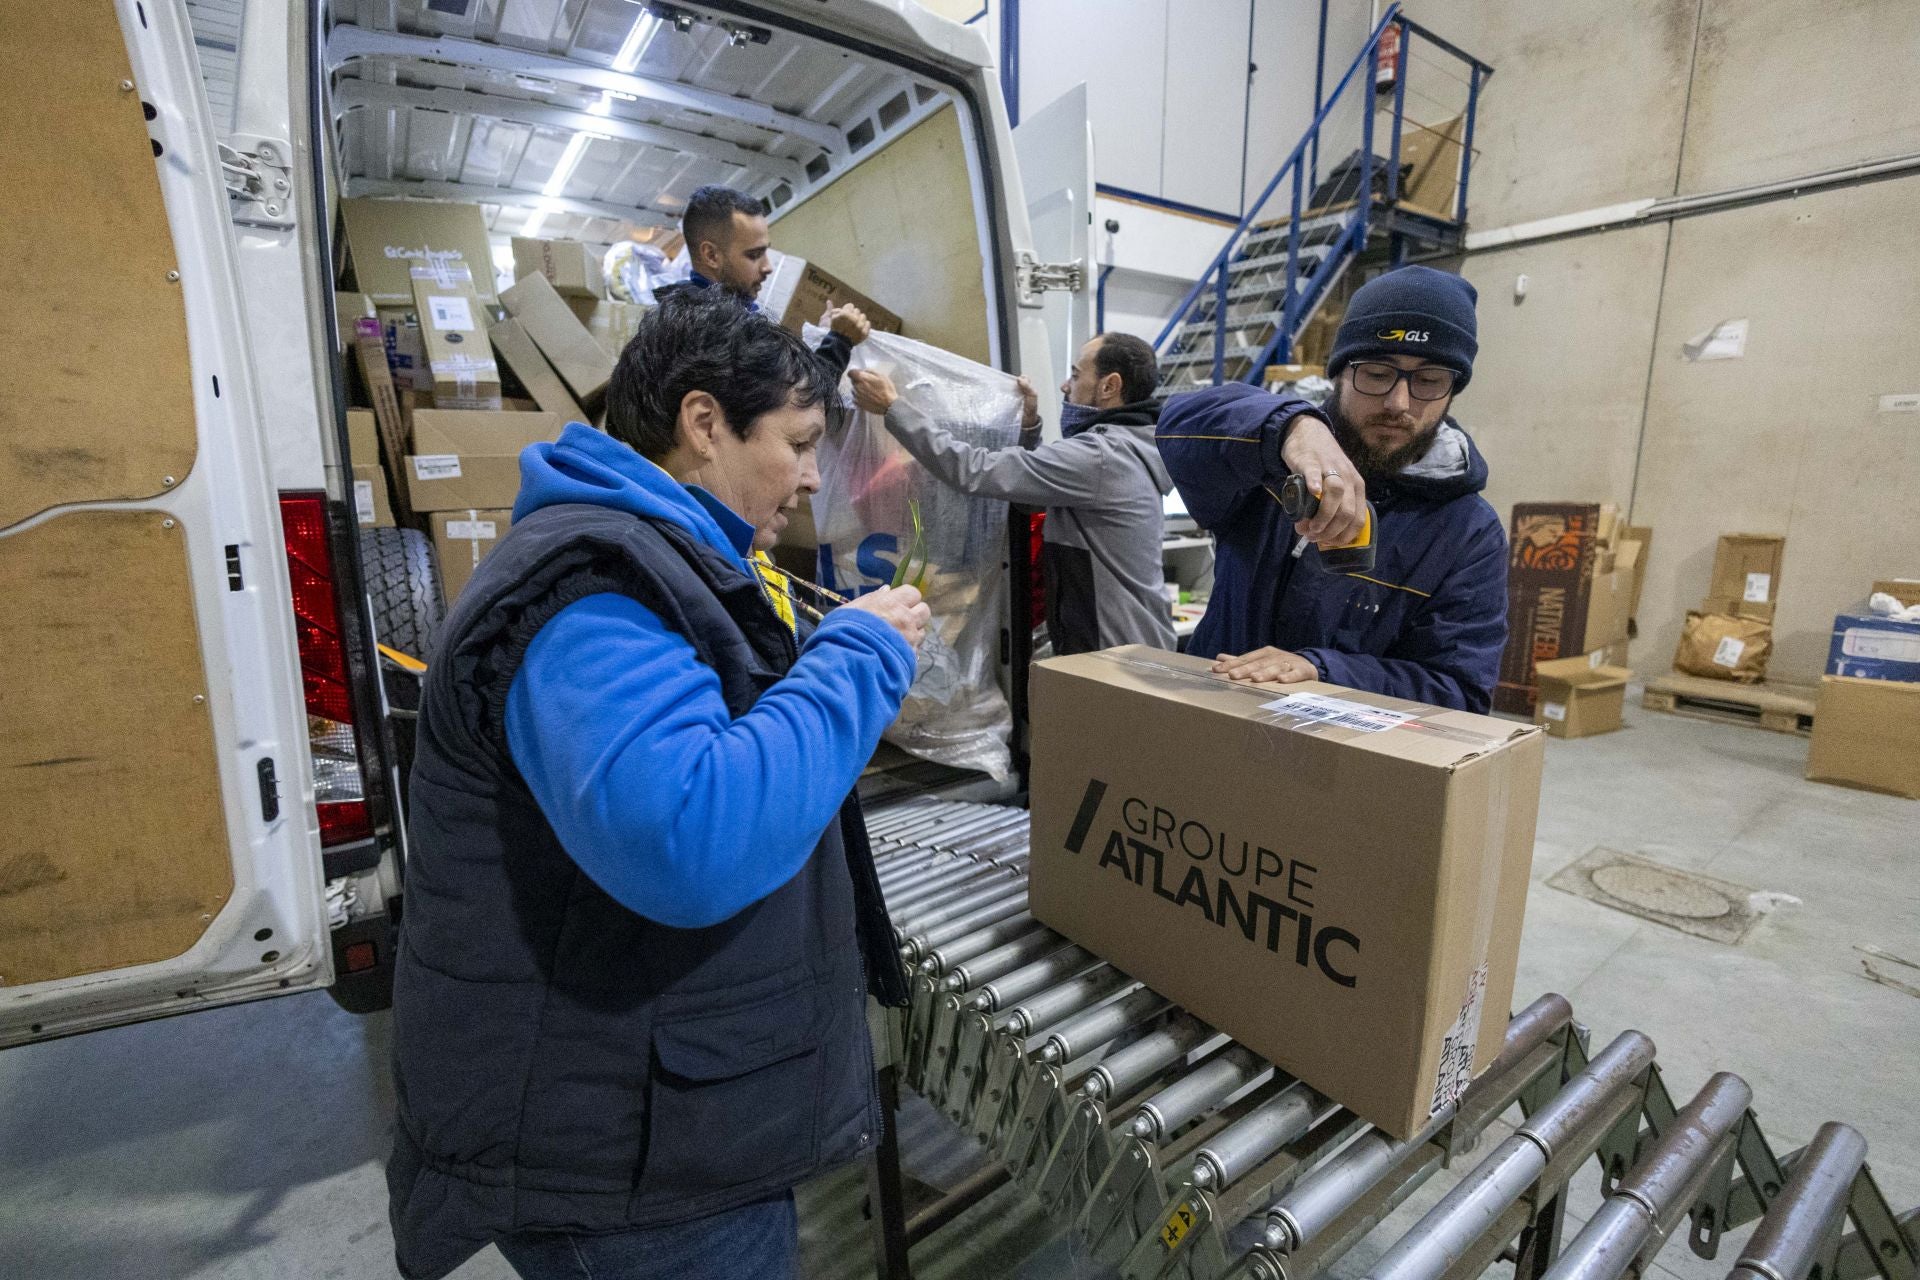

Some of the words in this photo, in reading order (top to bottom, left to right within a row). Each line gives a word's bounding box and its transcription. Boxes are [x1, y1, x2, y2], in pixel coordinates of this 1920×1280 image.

[807, 268, 836, 294] Terry
[1404, 330, 1431, 342] GLS
[1122, 797, 1318, 909] GROUPE
[1098, 830, 1361, 988] ATLANTIC
